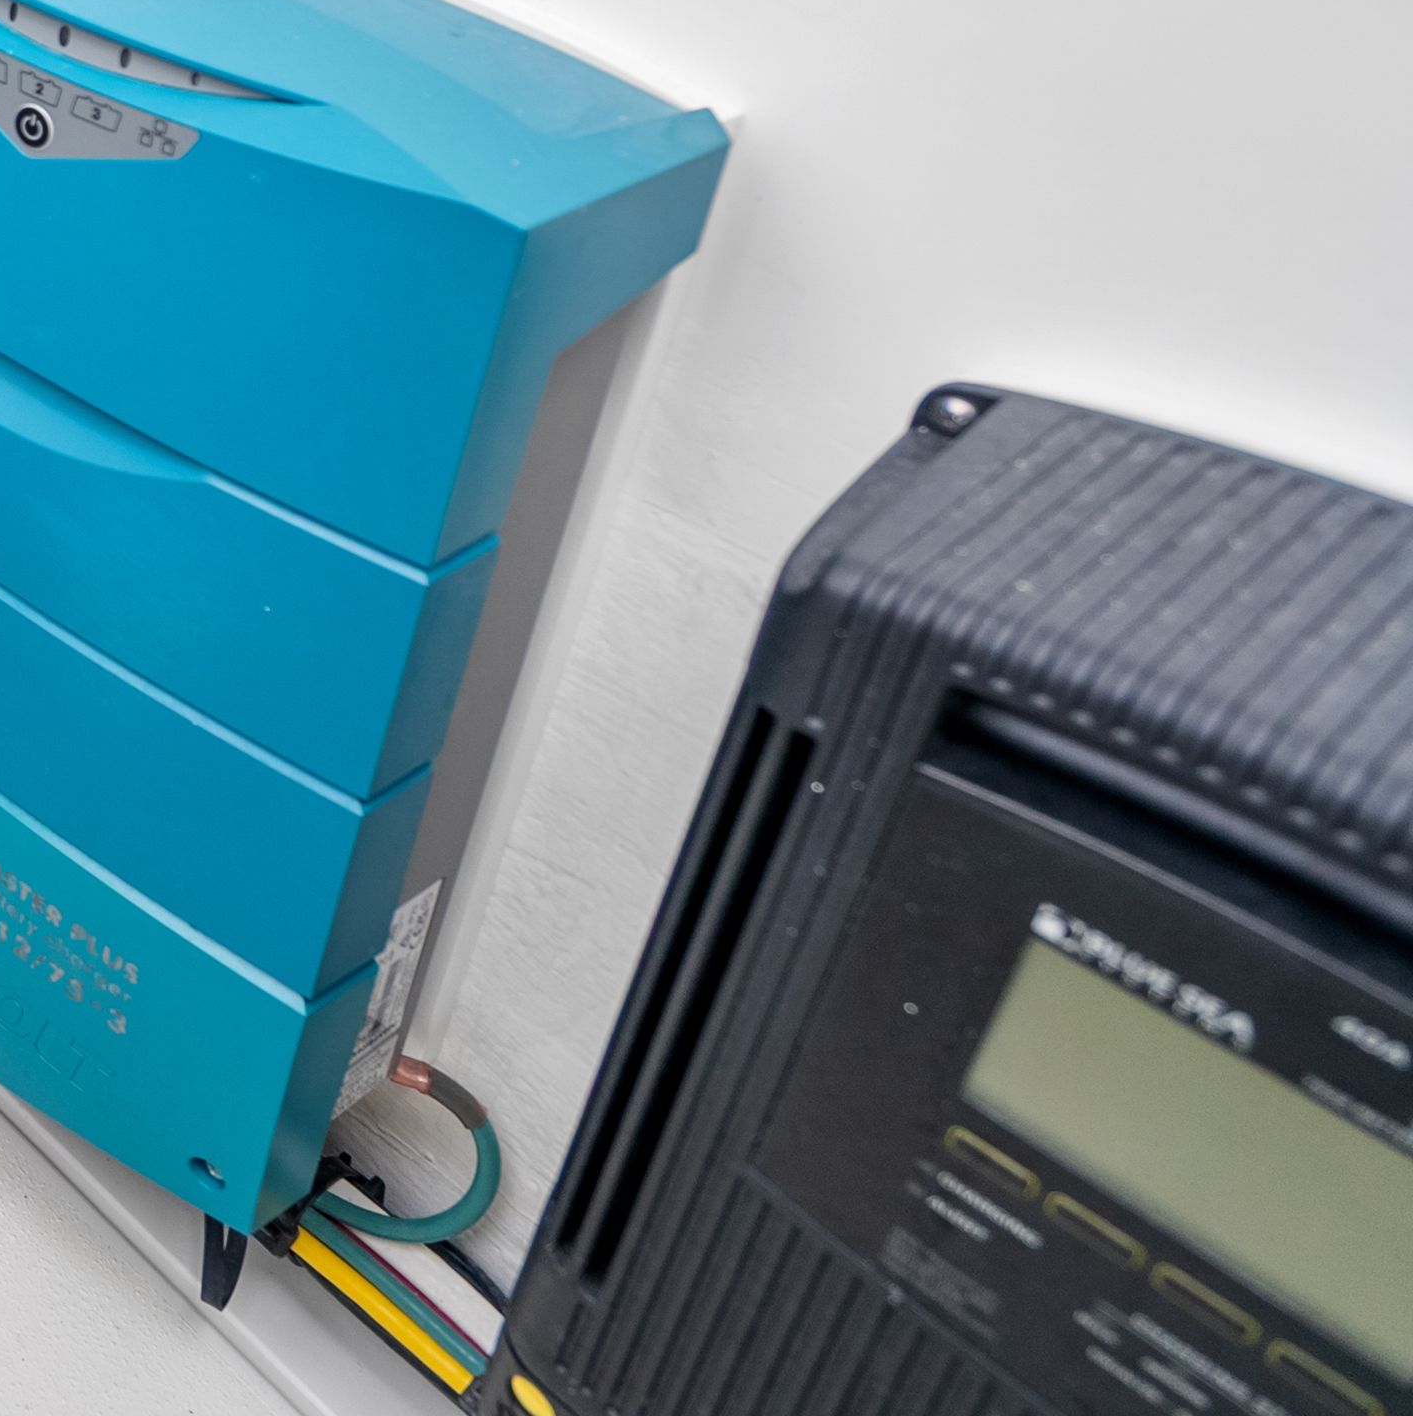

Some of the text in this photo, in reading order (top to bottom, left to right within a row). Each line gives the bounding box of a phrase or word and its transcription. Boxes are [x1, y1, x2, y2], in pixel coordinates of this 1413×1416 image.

[34, 83, 44, 96] 2
[91, 107, 102, 121] 3
[70, 923, 139, 984] PLUS
